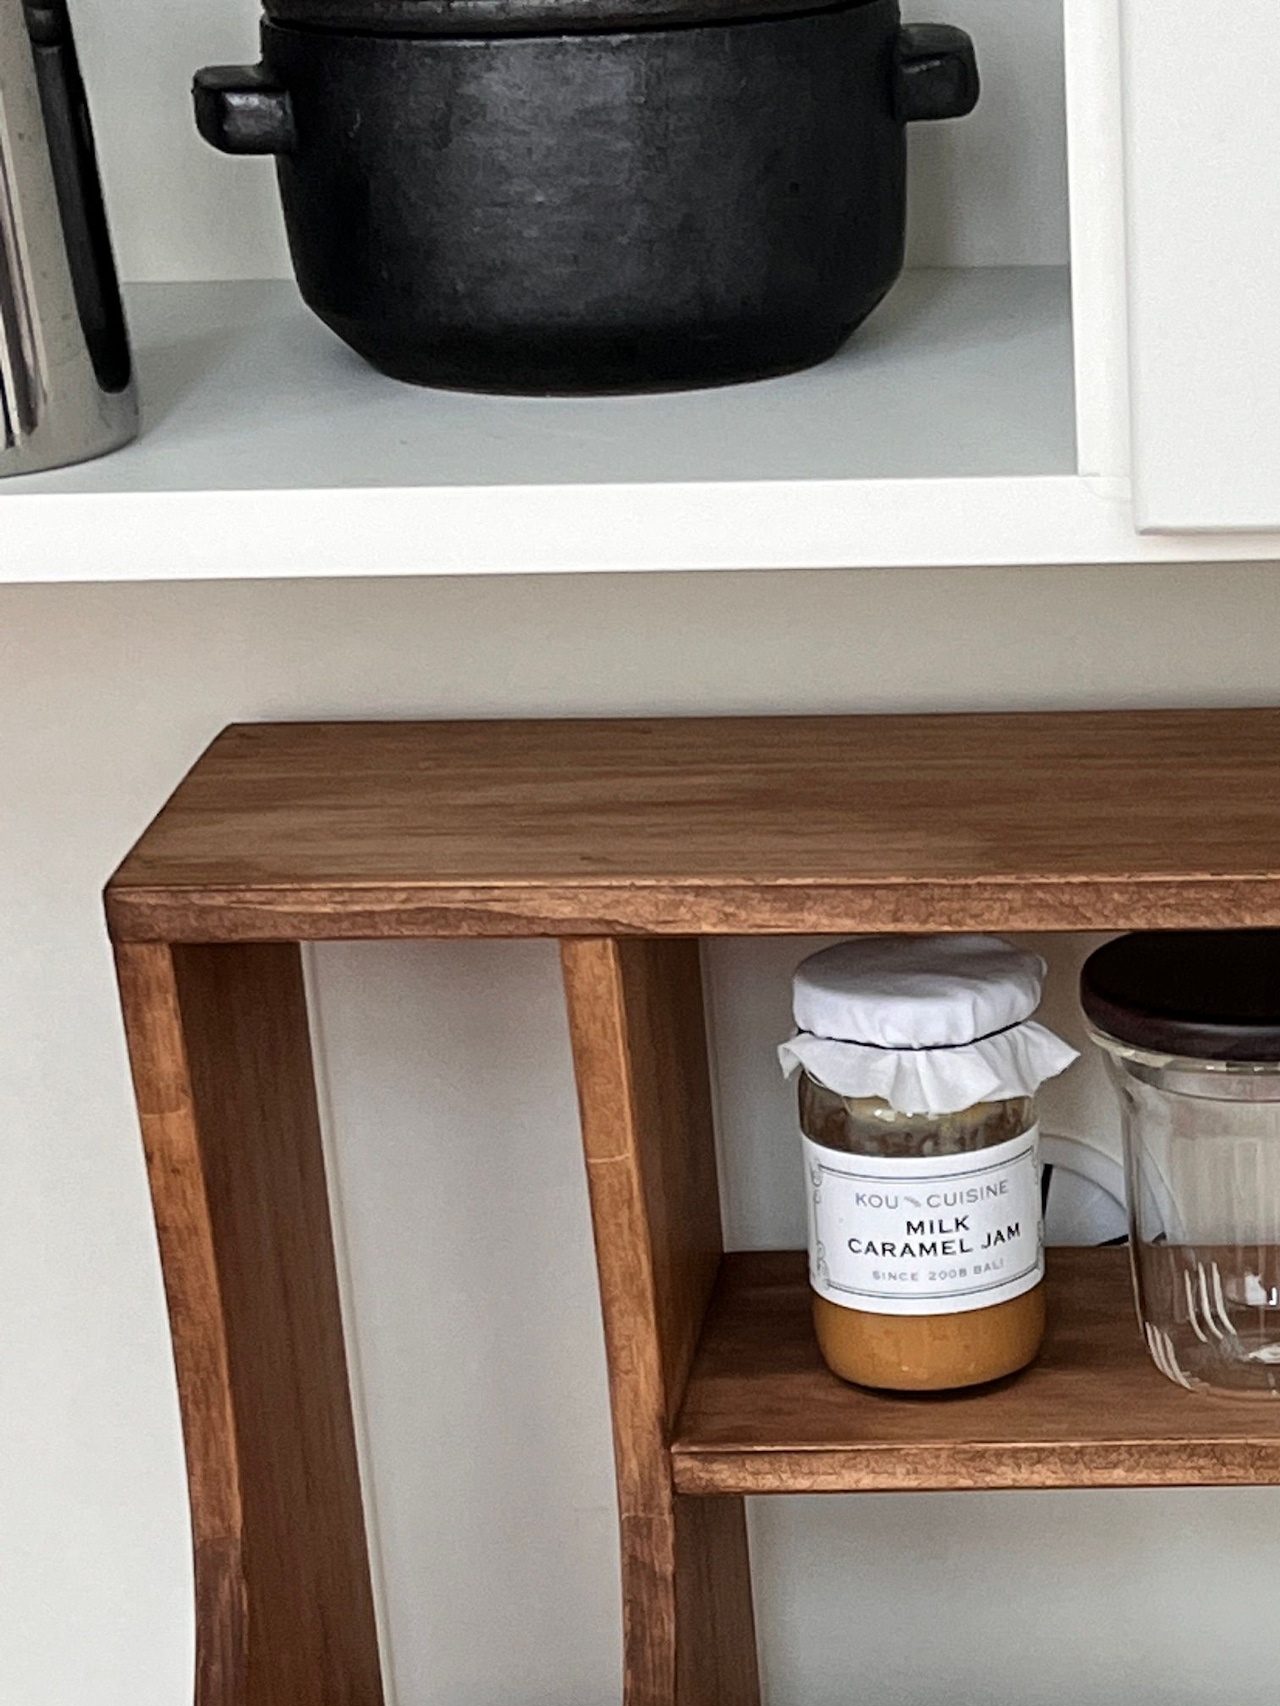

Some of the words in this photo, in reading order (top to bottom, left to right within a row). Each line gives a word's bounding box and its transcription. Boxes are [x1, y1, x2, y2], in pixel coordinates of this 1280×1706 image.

[855, 1192, 899, 1209] KOU
[926, 1179, 1009, 1208] CUISINE
[906, 1215, 970, 1236] MILK
[847, 1238, 973, 1258] CARAMEL
[981, 1222, 1021, 1249] JAM
[872, 1271, 919, 1281] SINCE
[973, 1258, 1004, 1275] BALI
